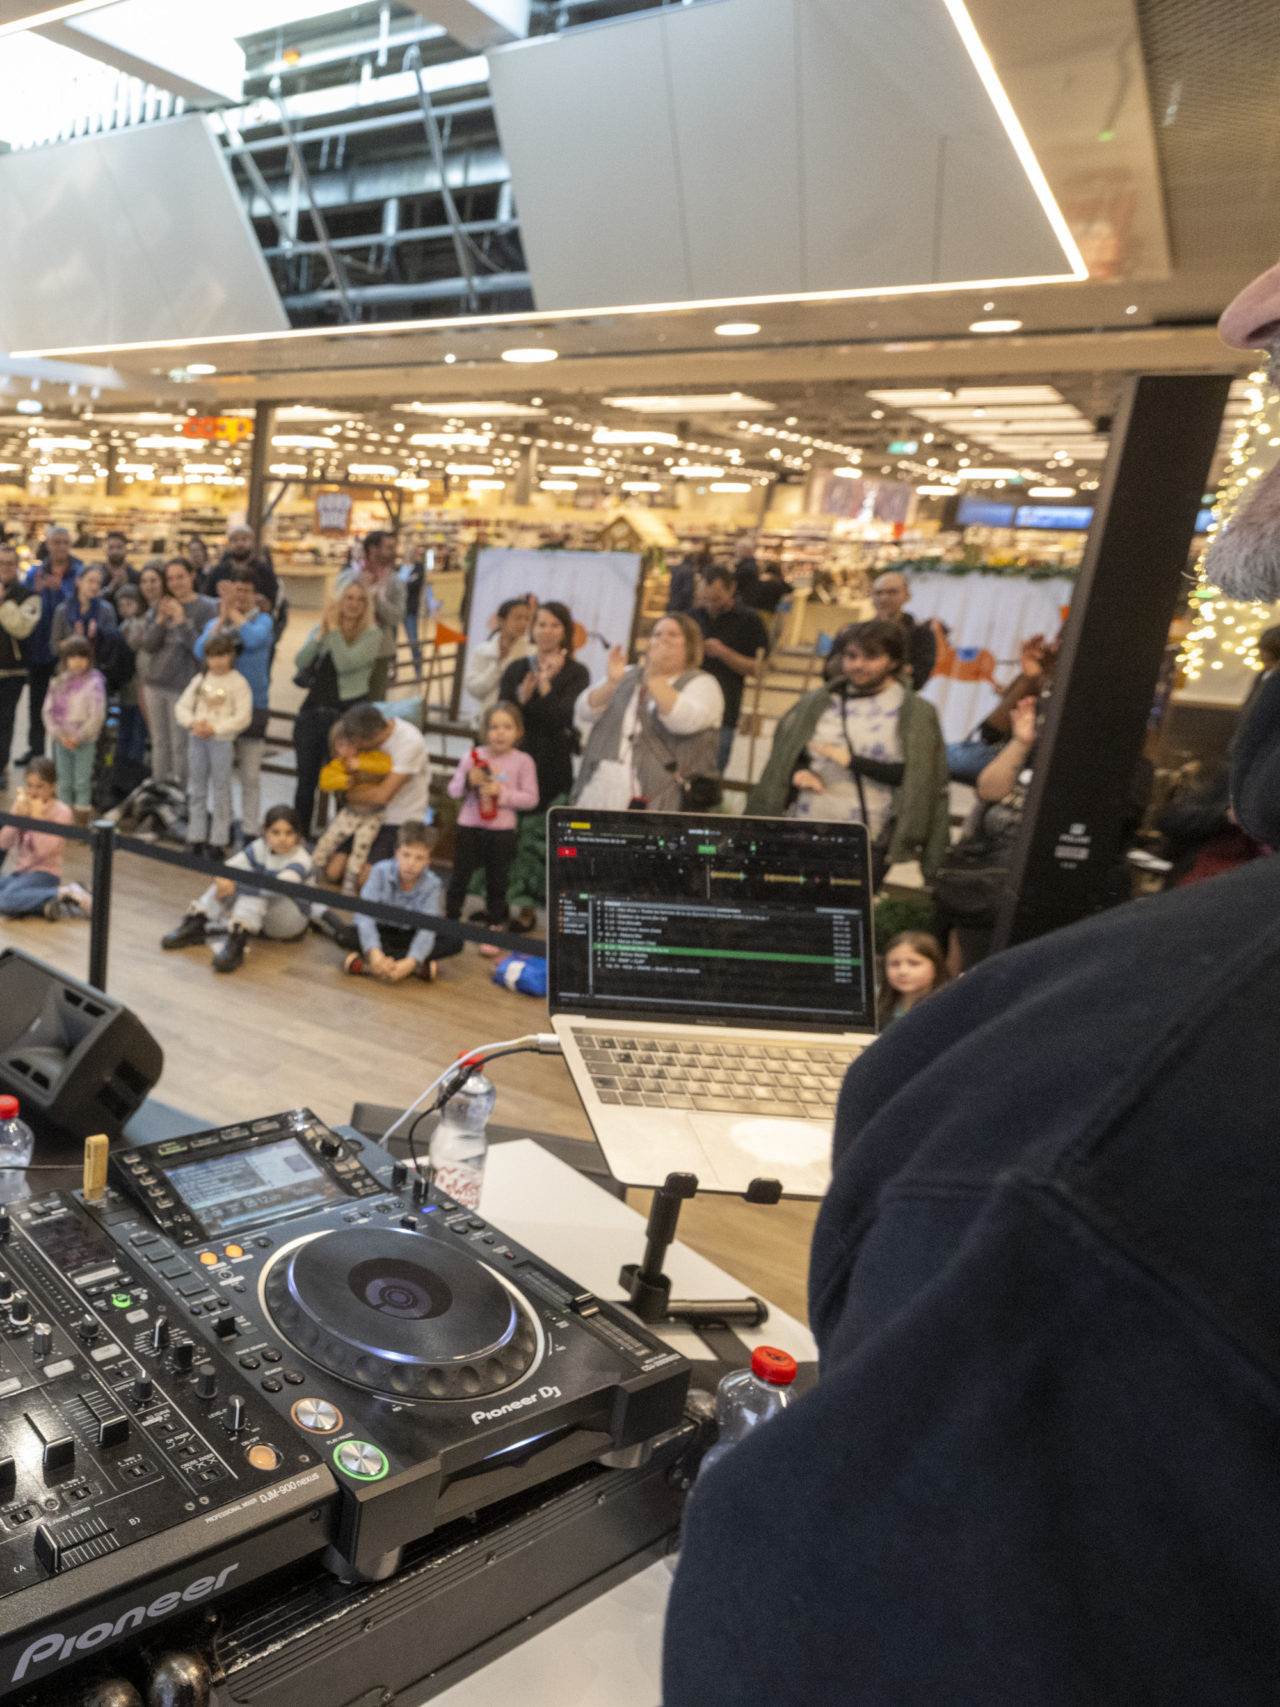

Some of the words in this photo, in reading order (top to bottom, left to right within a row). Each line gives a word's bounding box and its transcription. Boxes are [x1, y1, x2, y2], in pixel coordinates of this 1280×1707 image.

[471, 1394, 538, 1425] Pioneer
[537, 1385, 562, 1399] DJ
[259, 1481, 297, 1503] DJM-900
[10, 1562, 240, 1683] Pioneer
